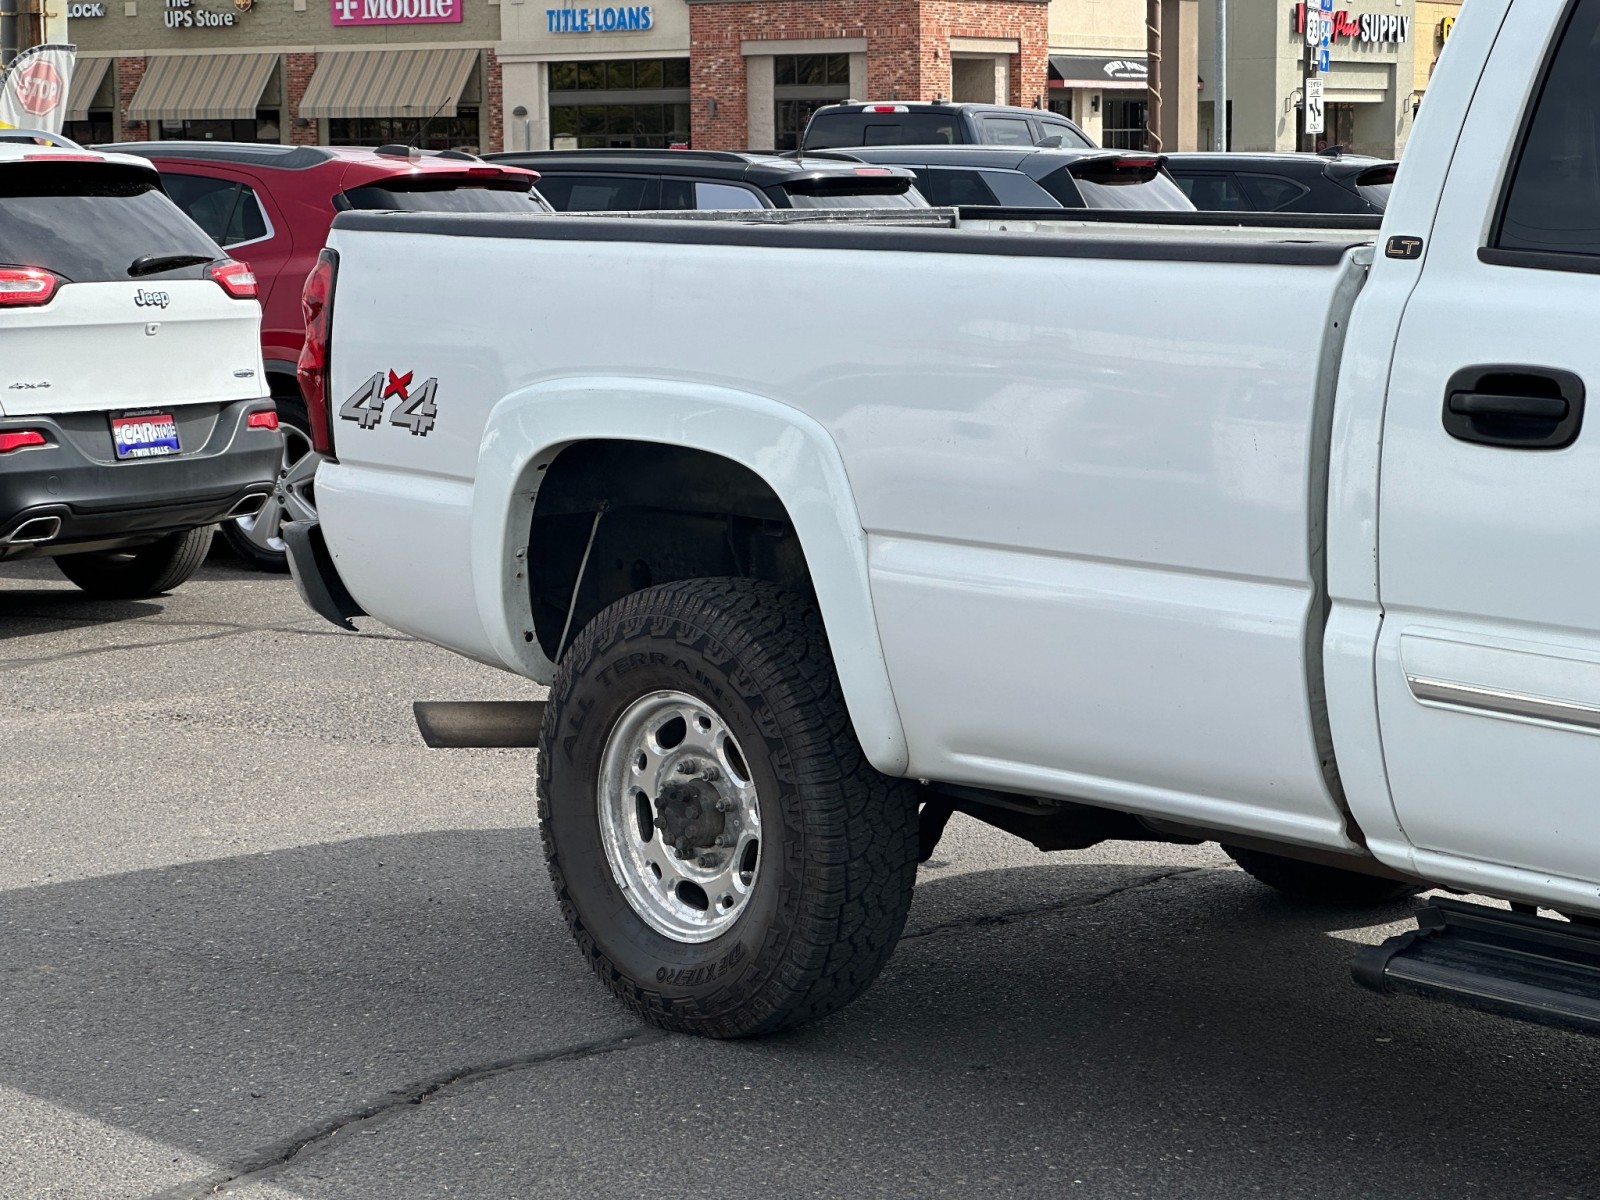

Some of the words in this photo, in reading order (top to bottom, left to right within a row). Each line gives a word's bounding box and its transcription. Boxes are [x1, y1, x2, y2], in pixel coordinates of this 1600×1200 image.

[164, 10, 193, 28] UPS
[196, 9, 234, 26] Store
[546, 8, 590, 32] TITLE
[594, 5, 653, 31] LOANS
[1309, 18, 1318, 39] 93
[1361, 14, 1410, 42] SUPPLY
[1320, 20, 1331, 39] 84
[23, 76, 58, 100] STOP
[1387, 239, 1420, 255] LT
[134, 289, 170, 308] Jeep
[121, 422, 155, 445] CAR
[132, 447, 150, 458] TWIN
[150, 445, 170, 456] FALLS
[562, 694, 596, 764] ALL
[594, 651, 724, 699] TERRAIN
